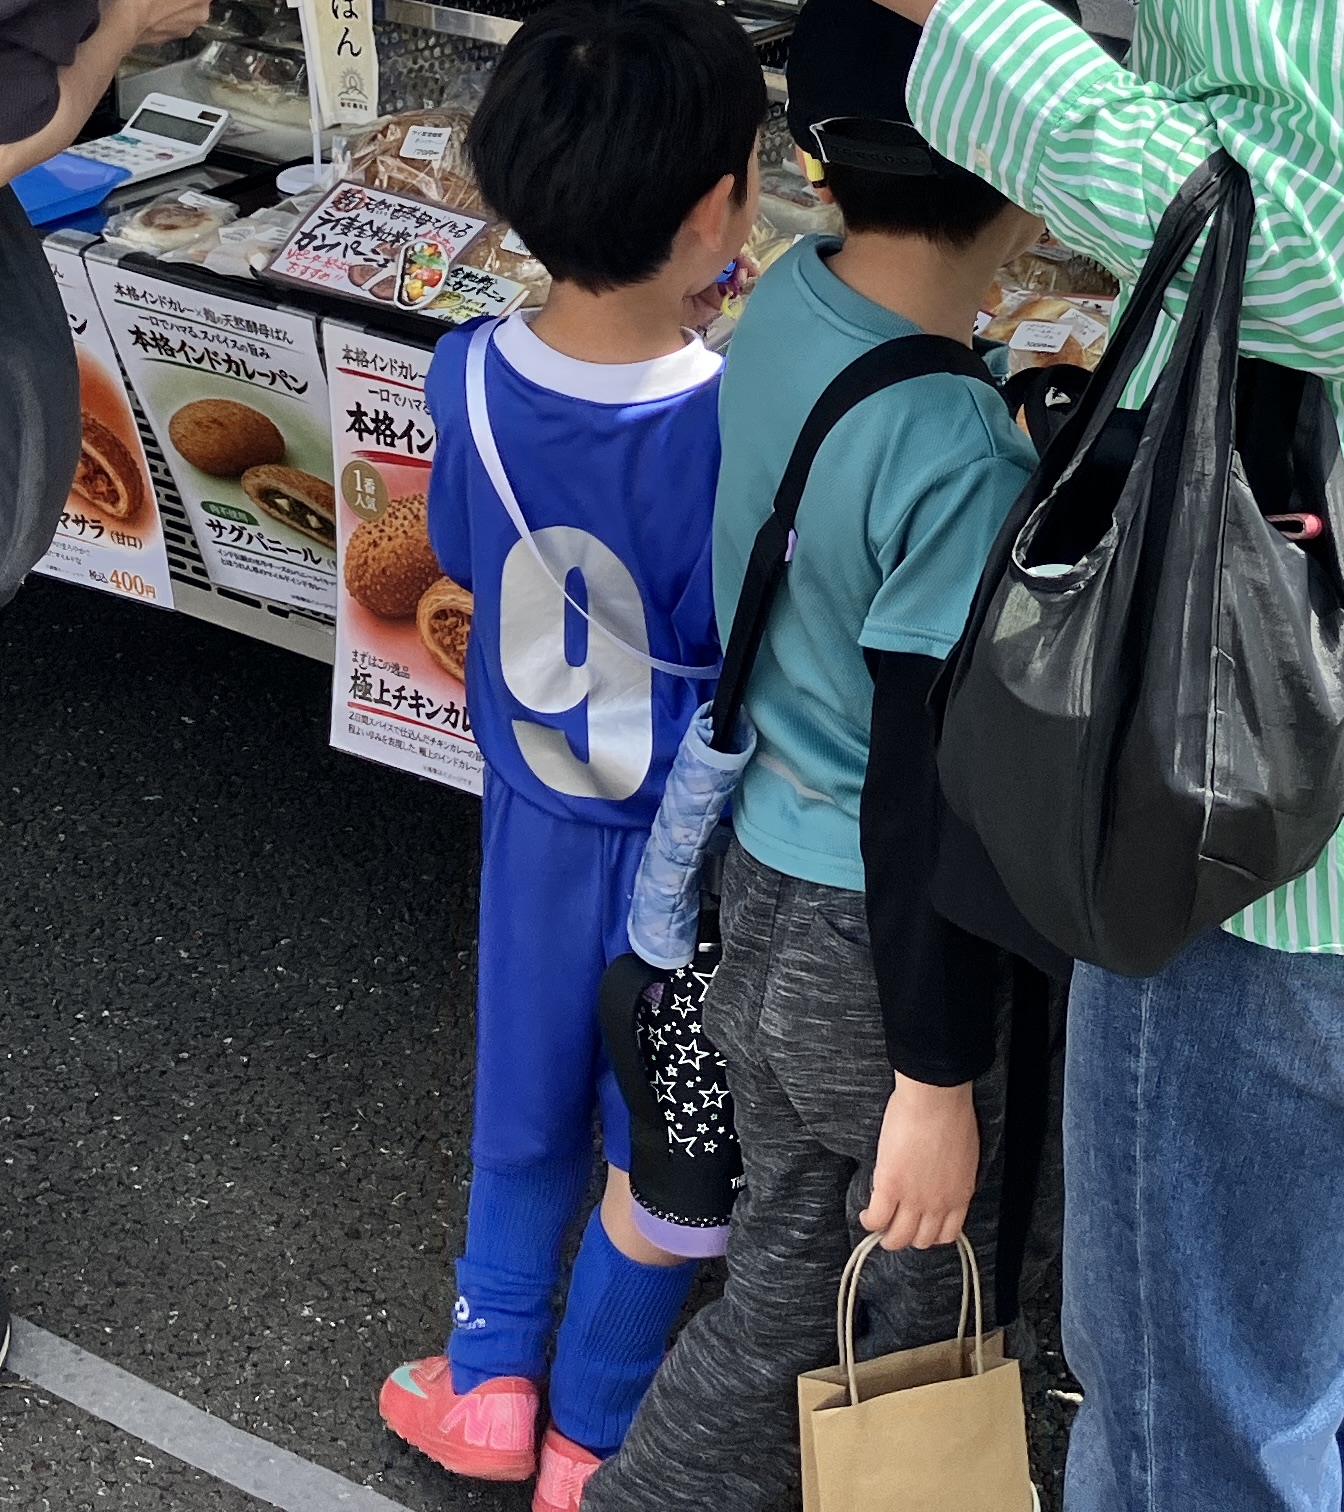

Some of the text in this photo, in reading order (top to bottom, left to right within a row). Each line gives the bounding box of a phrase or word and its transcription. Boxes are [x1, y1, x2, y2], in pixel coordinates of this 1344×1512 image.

[127, 323, 309, 396] 本格インドカレーパン
[345, 400, 439, 455] 本格イン
[354, 492, 378, 513] 人気
[204, 517, 323, 566] サグパニール
[109, 568, 157, 599] 400円
[499, 525, 654, 802] 9
